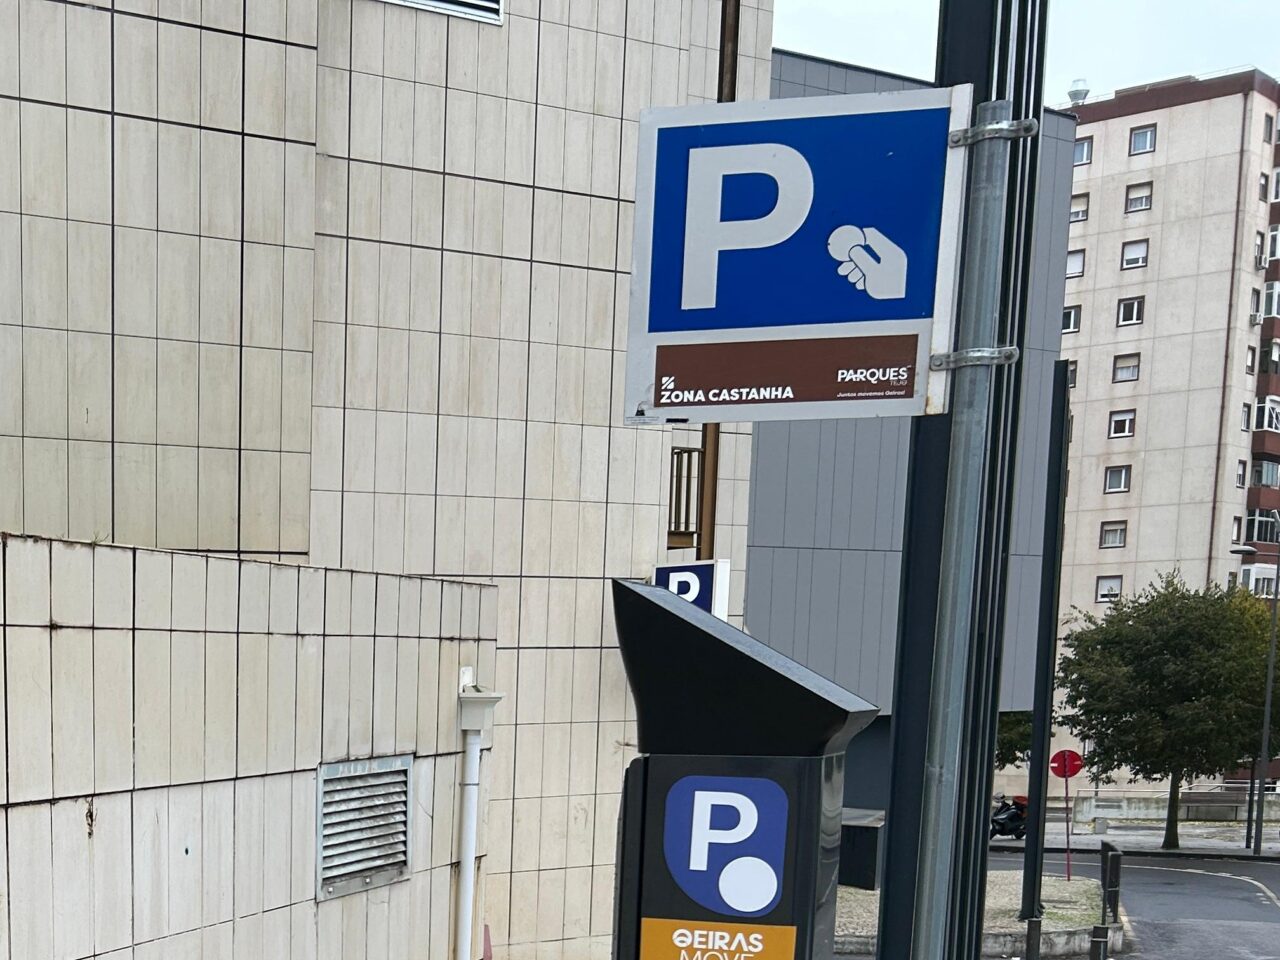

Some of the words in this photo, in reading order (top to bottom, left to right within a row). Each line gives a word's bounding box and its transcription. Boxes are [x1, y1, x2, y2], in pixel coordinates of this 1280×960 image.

[681, 143, 814, 310] P
[837, 367, 908, 384] PARQUES
[660, 390, 706, 404] ZONA
[709, 386, 794, 402] CASTANHA
[668, 571, 701, 603] P
[689, 790, 759, 872] P
[672, 928, 764, 953] OEIRAS
